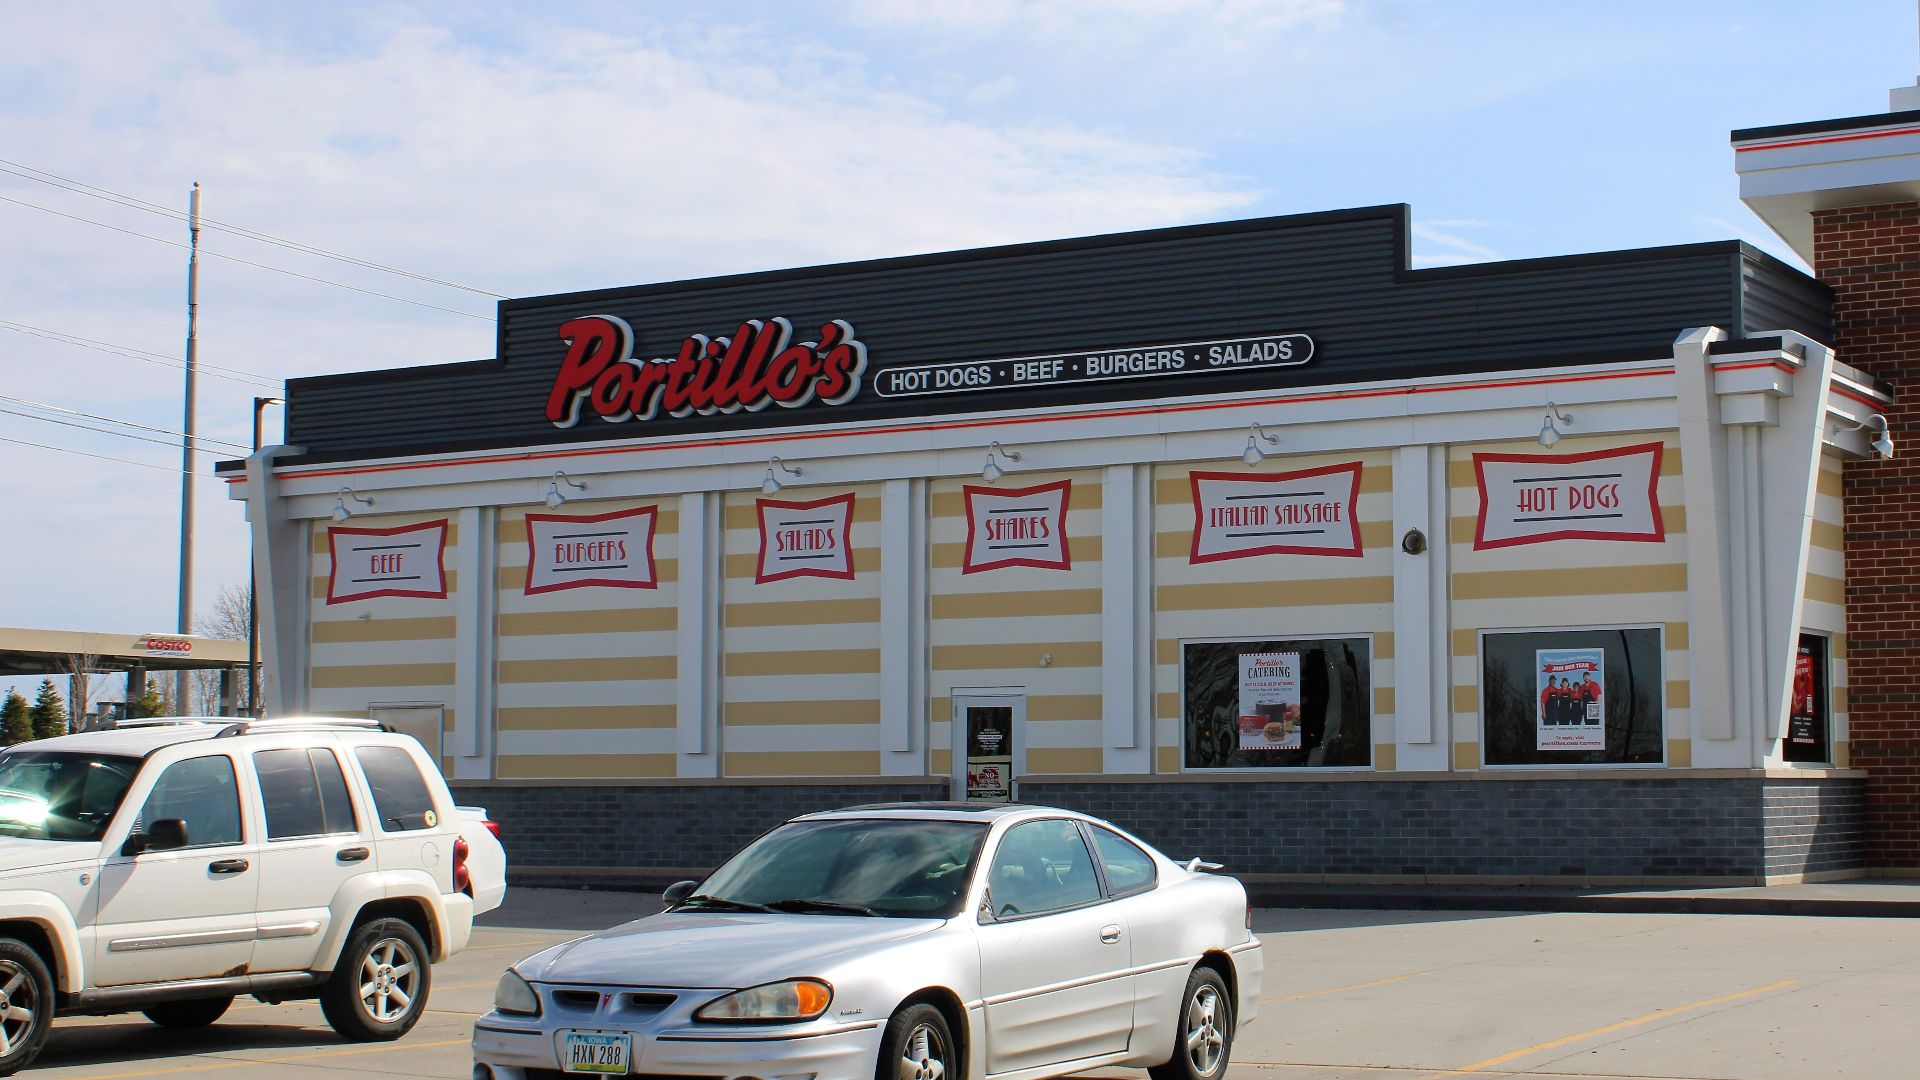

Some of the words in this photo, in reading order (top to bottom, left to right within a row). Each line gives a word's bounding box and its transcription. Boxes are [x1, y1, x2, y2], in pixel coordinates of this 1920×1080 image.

[545, 314, 868, 428] Portillo's
[891, 370, 931, 391] HOT
[935, 366, 992, 388] DOGS
[1013, 360, 1064, 382] BEEF
[1086, 349, 1186, 376] BURGERS
[1208, 340, 1293, 365] SALADS
[1516, 486, 1558, 513] HOT
[1569, 483, 1620, 510] DOGS
[1210, 504, 1269, 528] ITALIAN
[1274, 501, 1342, 526] SAUSAGE
[776, 527, 836, 552] SALADS
[985, 516, 1050, 541] SHAKES
[370, 553, 404, 575] BEEF
[555, 540, 627, 564] BURGERS
[147, 638, 192, 651] COSTCO
[1248, 667, 1291, 679] CATERING
[588, 1036, 607, 1044] IOWA
[573, 1045, 596, 1063] HXN
[599, 1045, 621, 1065] 288
